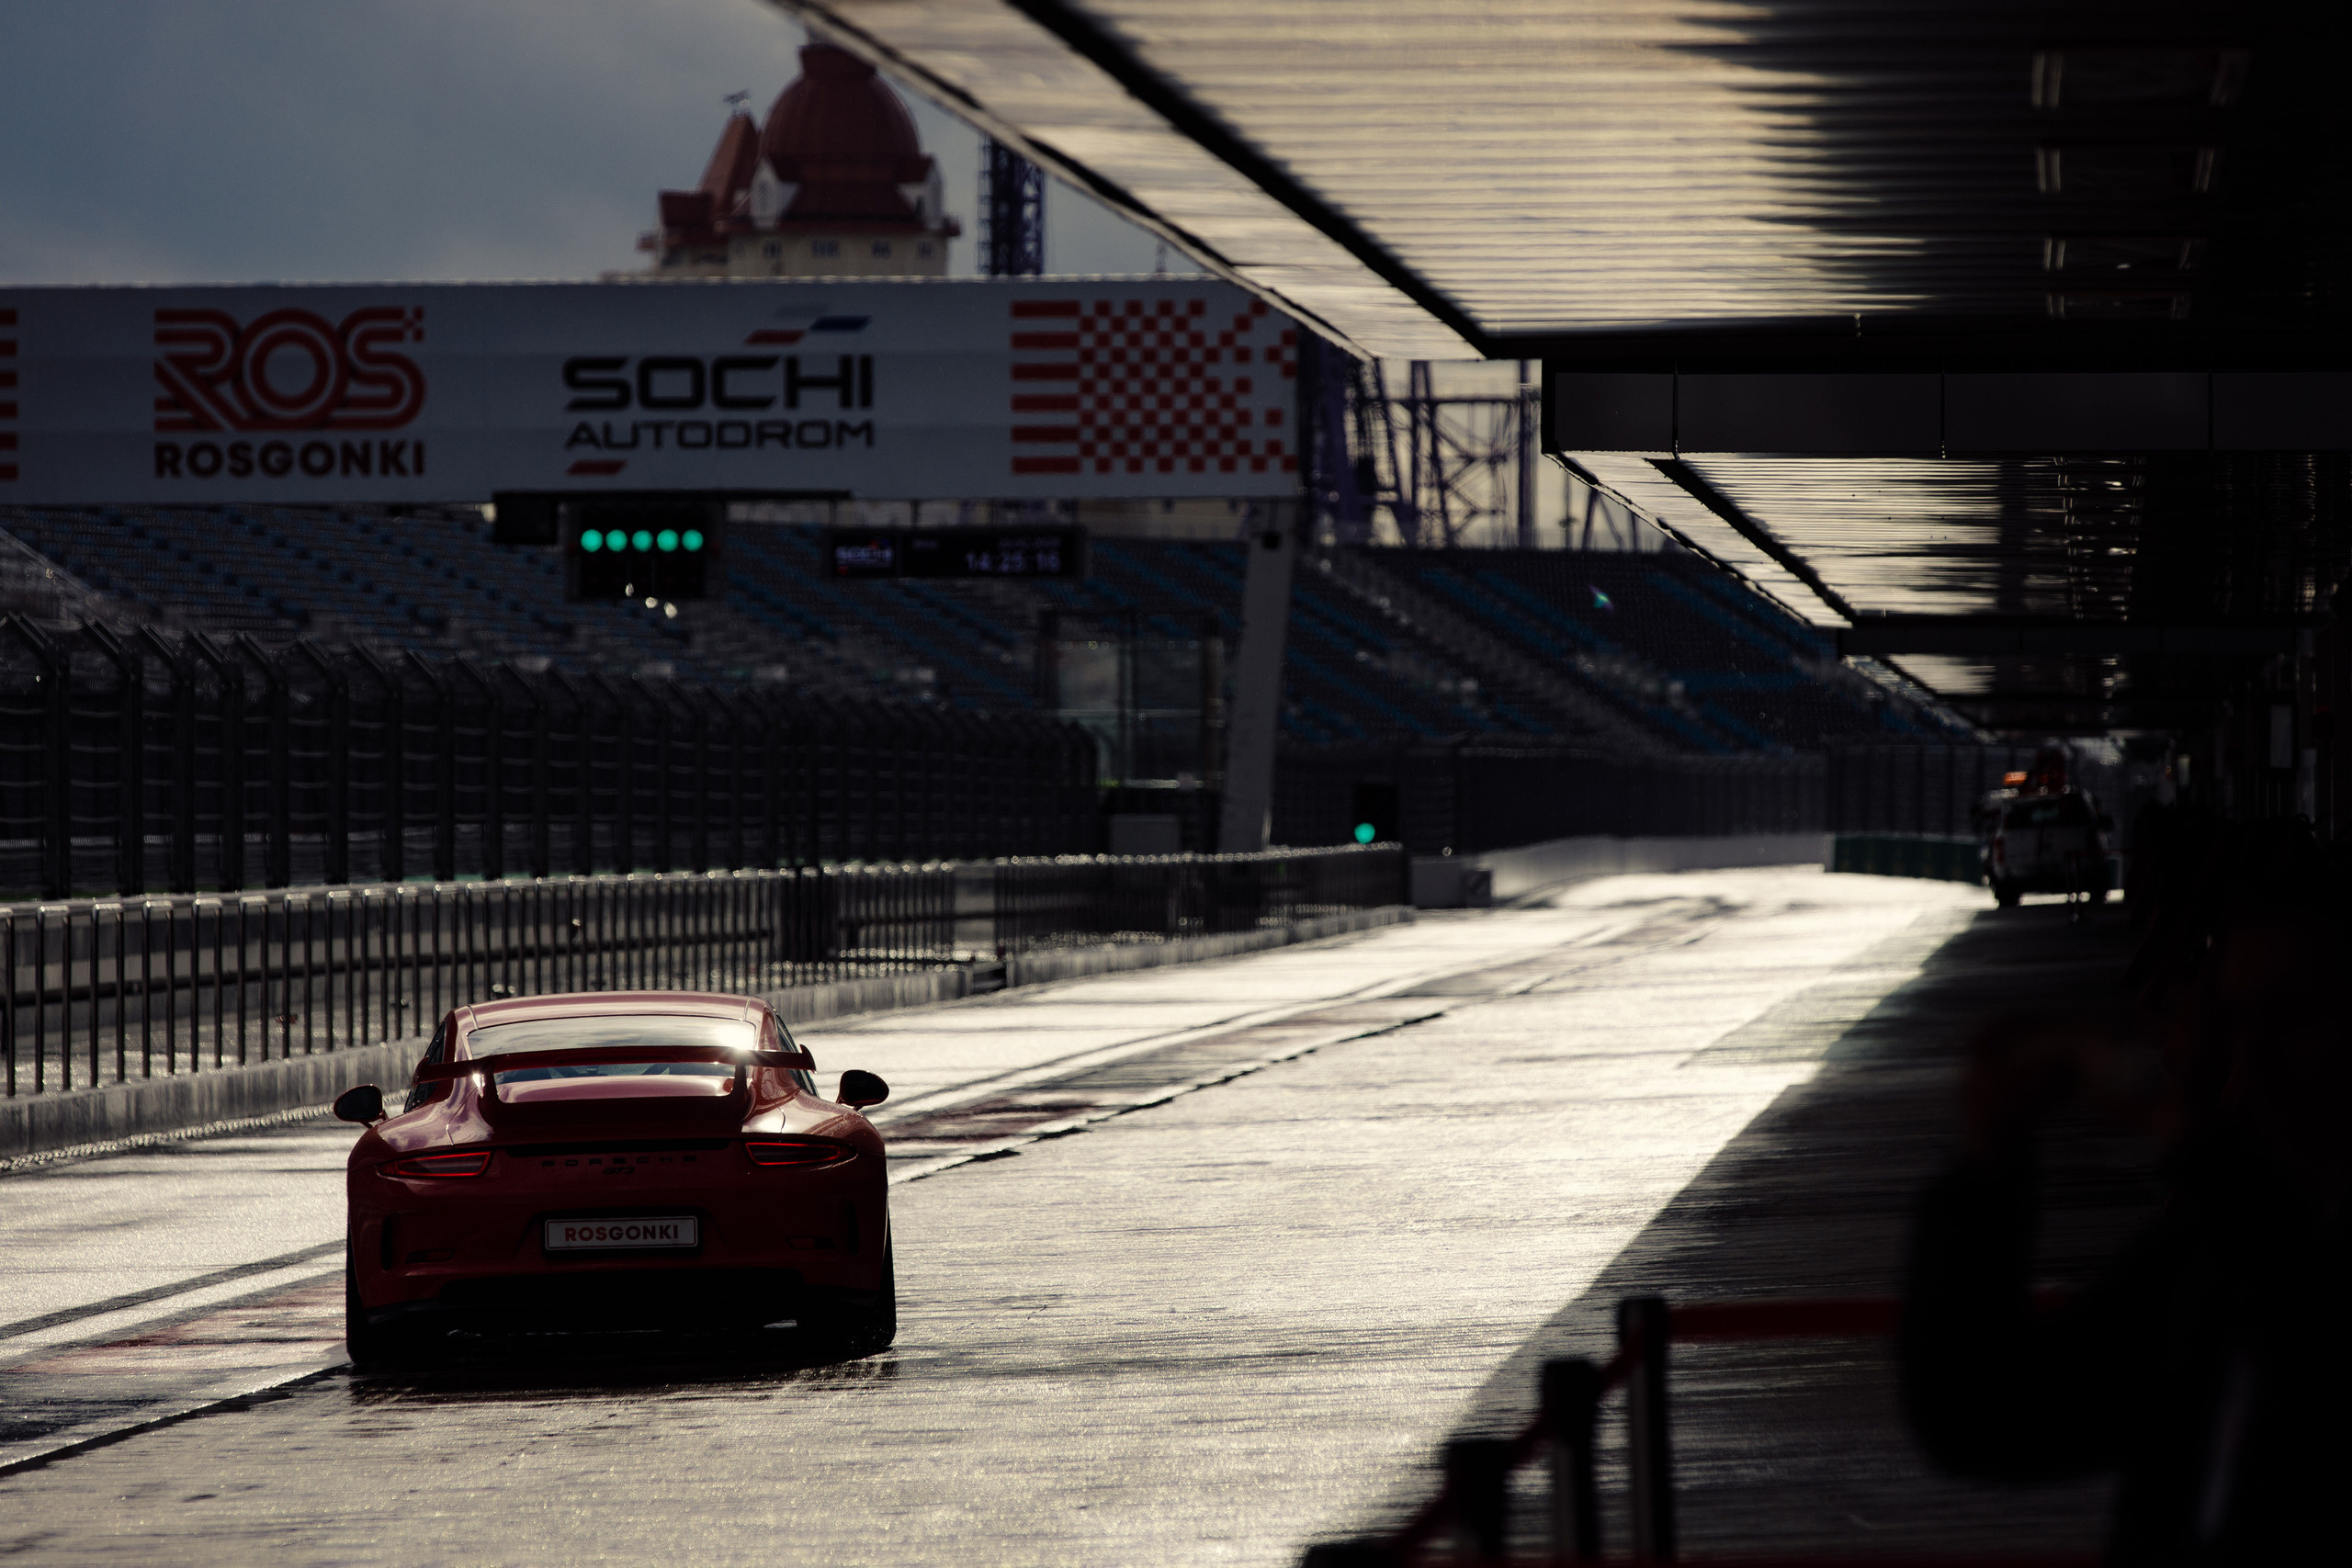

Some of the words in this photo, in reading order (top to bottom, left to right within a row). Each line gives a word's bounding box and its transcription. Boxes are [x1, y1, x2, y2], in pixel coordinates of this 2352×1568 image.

[154, 308, 424, 431] ROS
[563, 355, 872, 410] SOCHI
[565, 421, 873, 449] AUTODROM
[155, 440, 424, 477] ROSGONKI
[542, 1156, 695, 1168] PORSCHE
[565, 1224, 678, 1242] ROSGONKI
